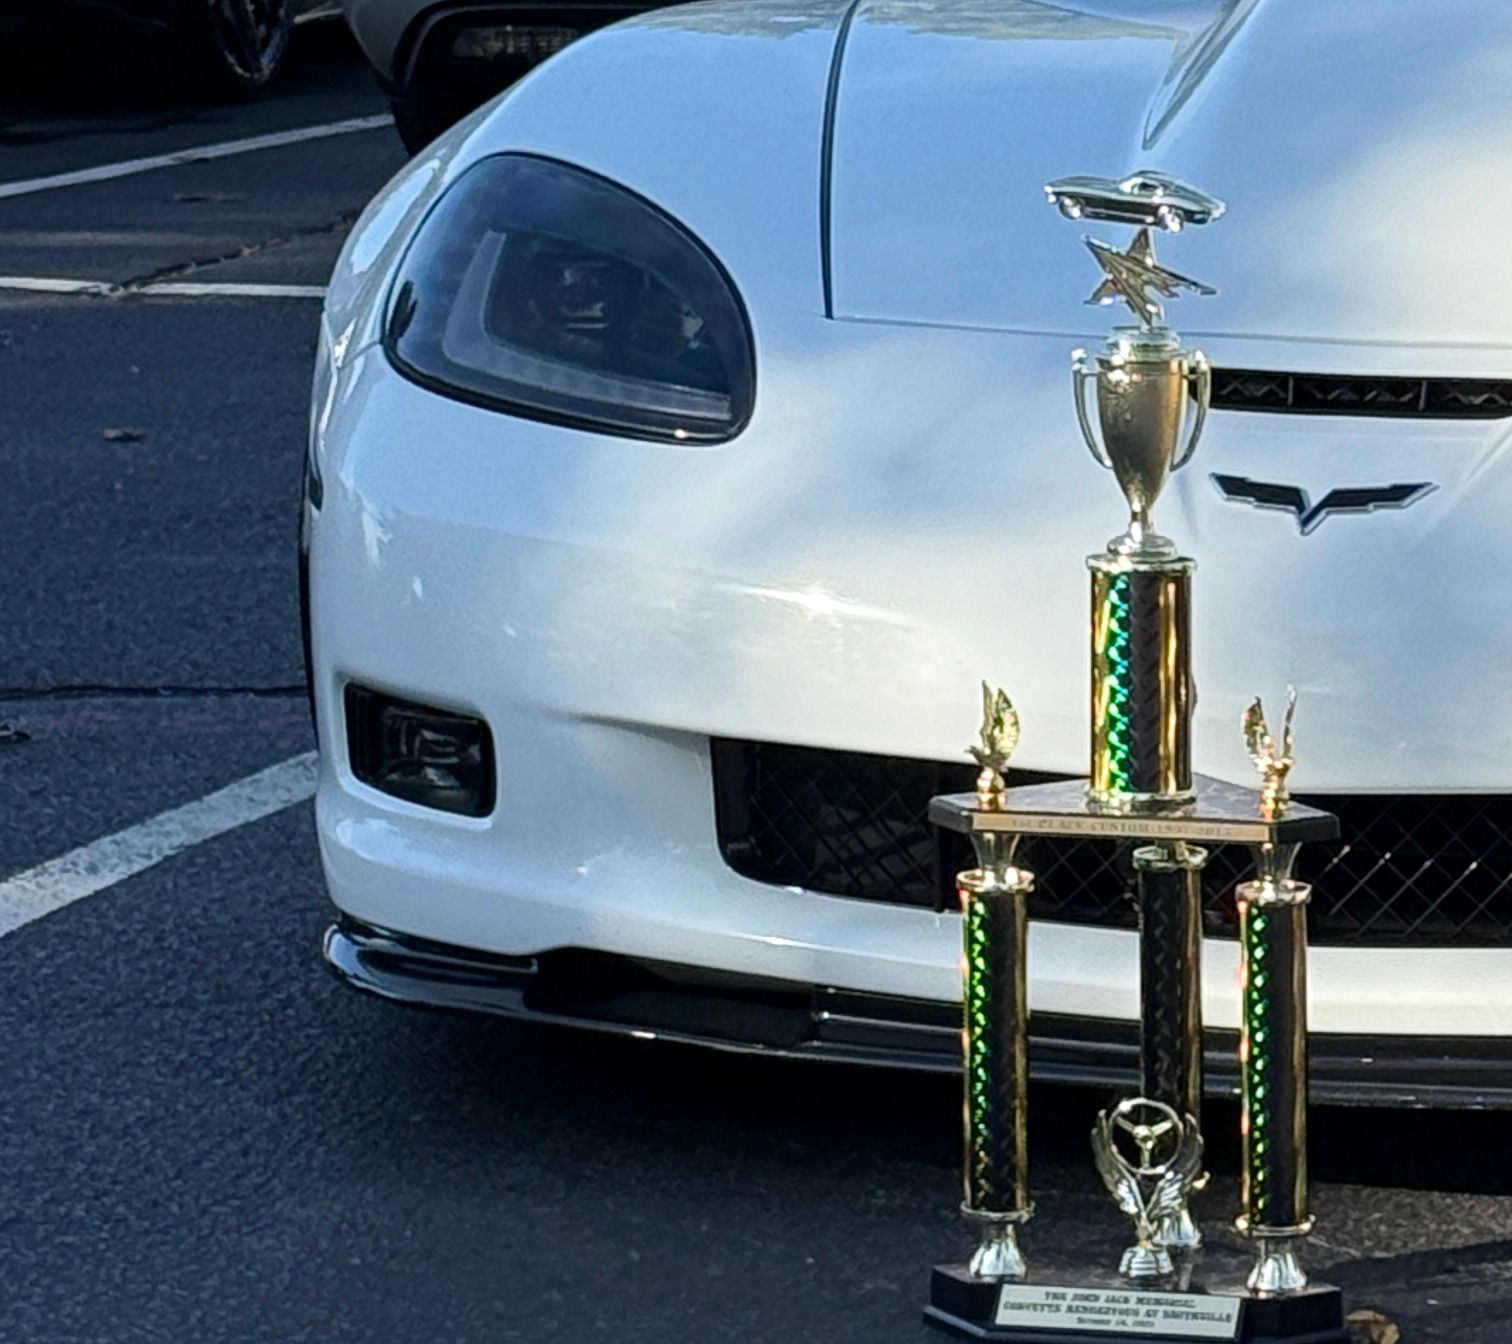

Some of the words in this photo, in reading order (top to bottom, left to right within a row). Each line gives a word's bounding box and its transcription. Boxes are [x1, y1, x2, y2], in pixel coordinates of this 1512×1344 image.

[1090, 821, 1150, 833] CUSTOM
[1044, 1291, 1067, 1301] THE
[1003, 1300, 1061, 1313] CORVETTE
